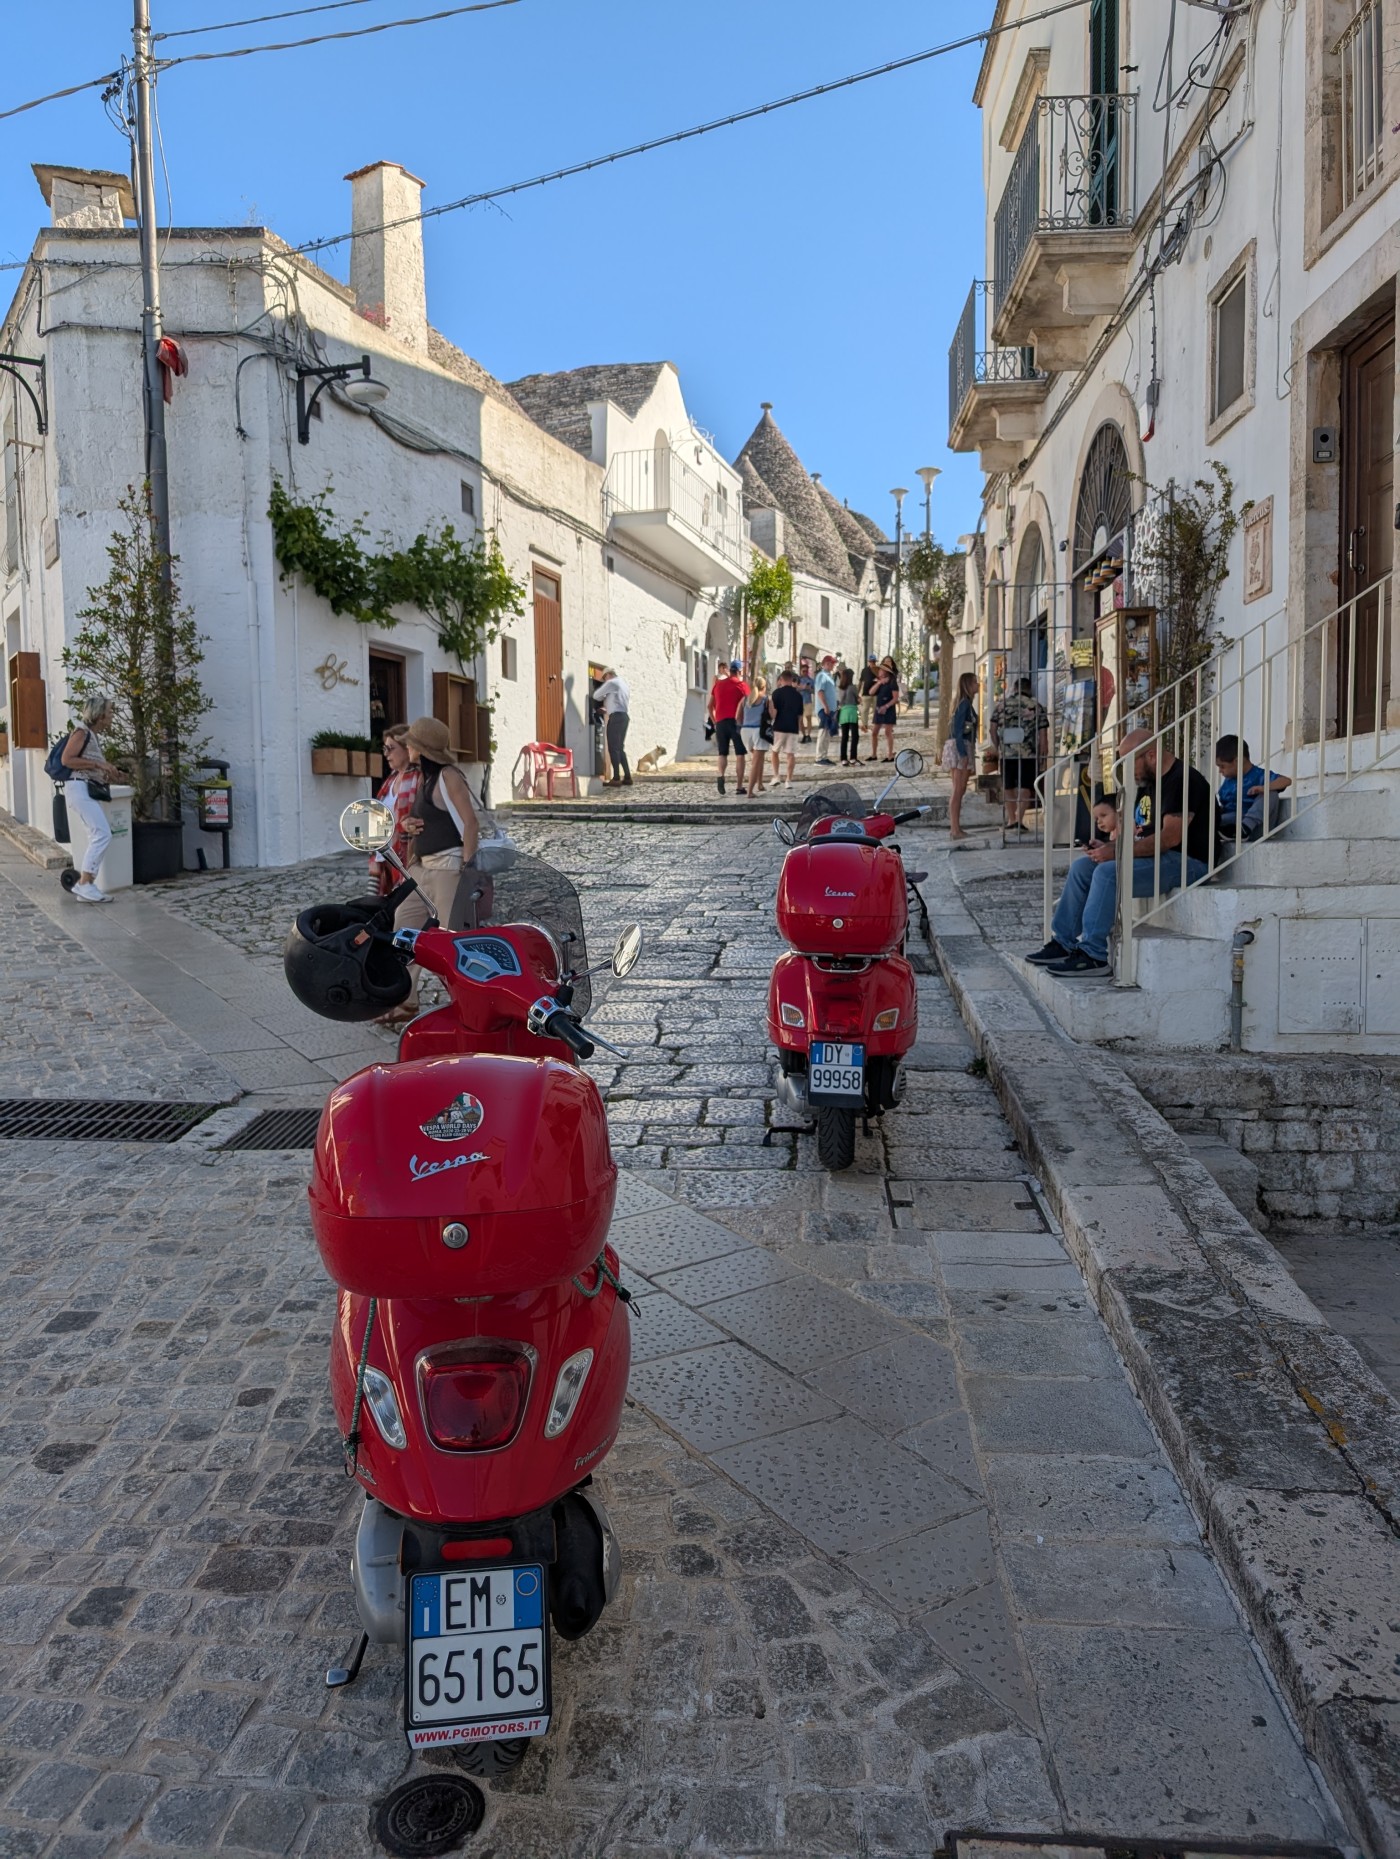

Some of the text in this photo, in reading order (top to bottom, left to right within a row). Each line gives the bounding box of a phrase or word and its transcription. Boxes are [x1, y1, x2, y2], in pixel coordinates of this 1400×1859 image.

[824, 886, 856, 897] Vespa
[824, 1044, 843, 1063] DY
[813, 1068, 861, 1090] 99958
[422, 1124, 440, 1132] VESPA
[409, 1151, 491, 1182] Vespa
[445, 1574, 493, 1631] EM
[418, 1642, 539, 1706] 65165
[414, 1719, 541, 1744] WWW.PGMOTORS.IT
